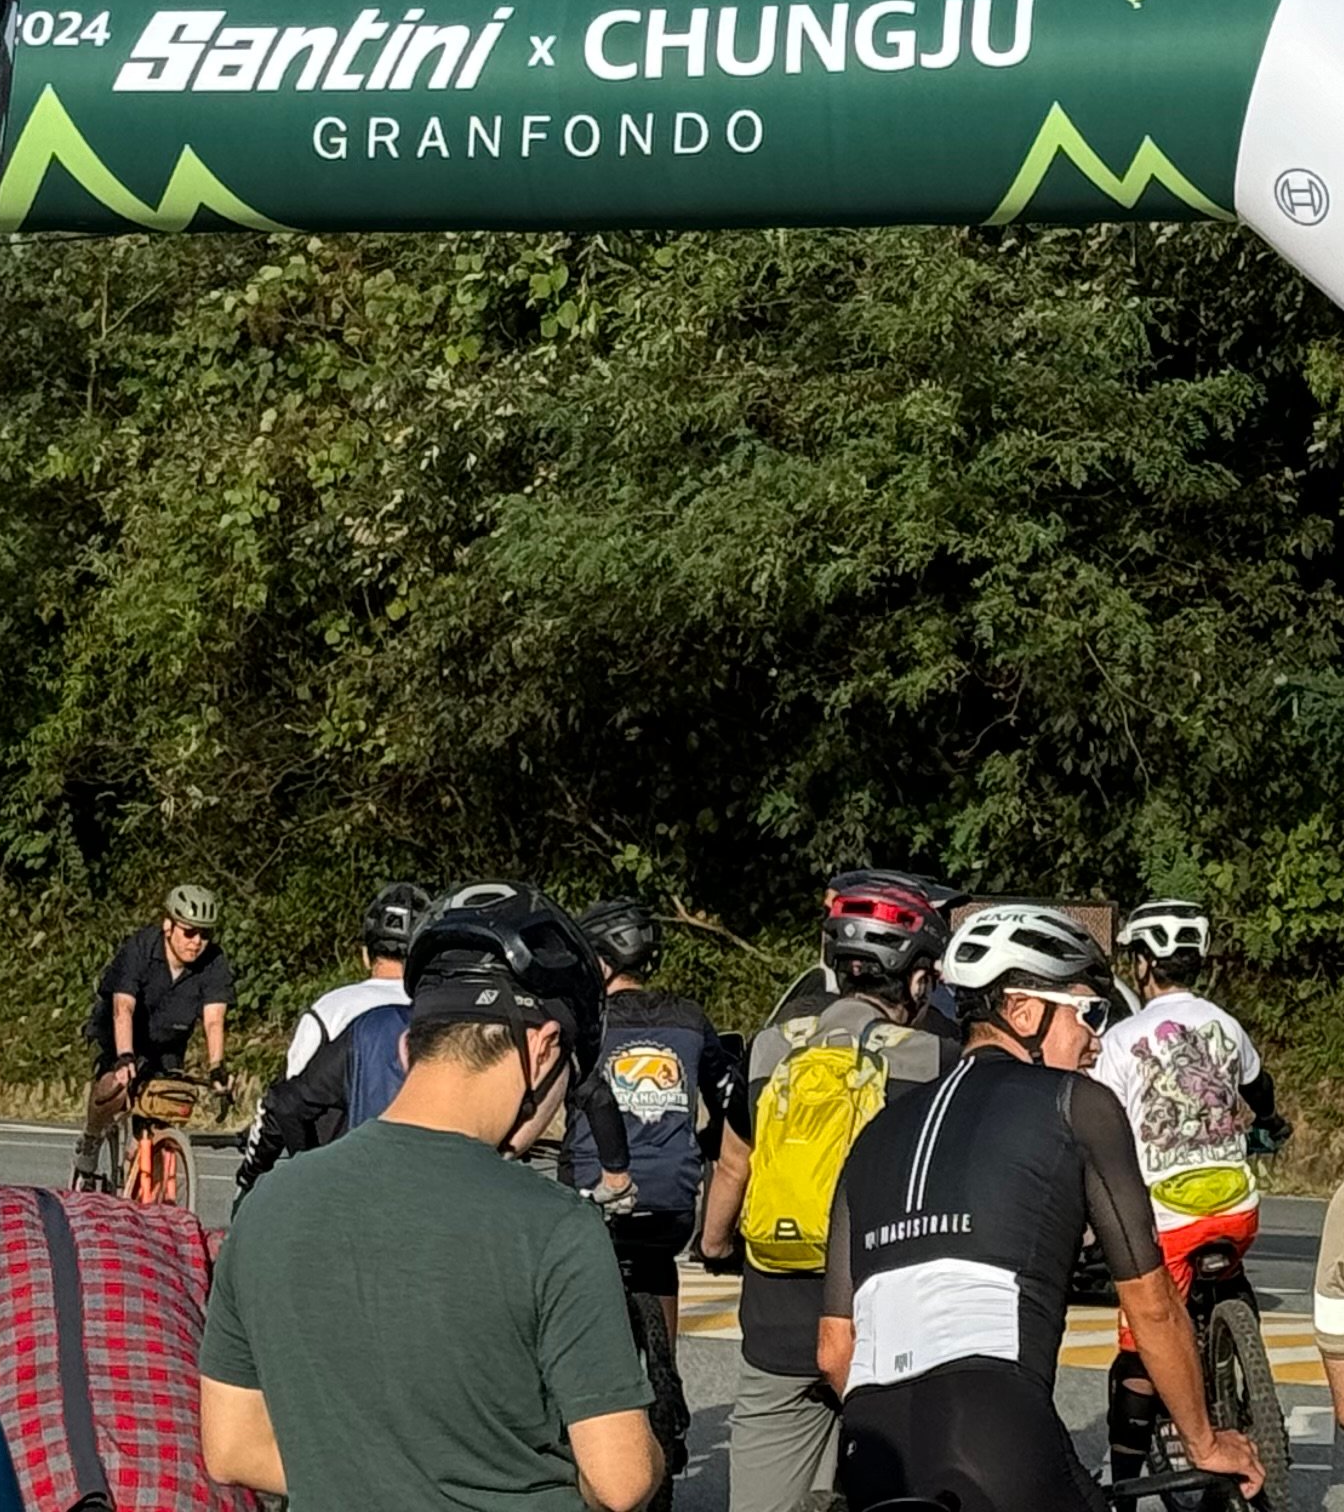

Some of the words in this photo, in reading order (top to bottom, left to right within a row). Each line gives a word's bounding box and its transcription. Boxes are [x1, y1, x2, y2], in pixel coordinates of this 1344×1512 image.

[13, 10, 111, 47] 024
[113, 6, 515, 91] Santini
[527, 34, 556, 67] x
[312, 108, 764, 161] GRANFONDO
